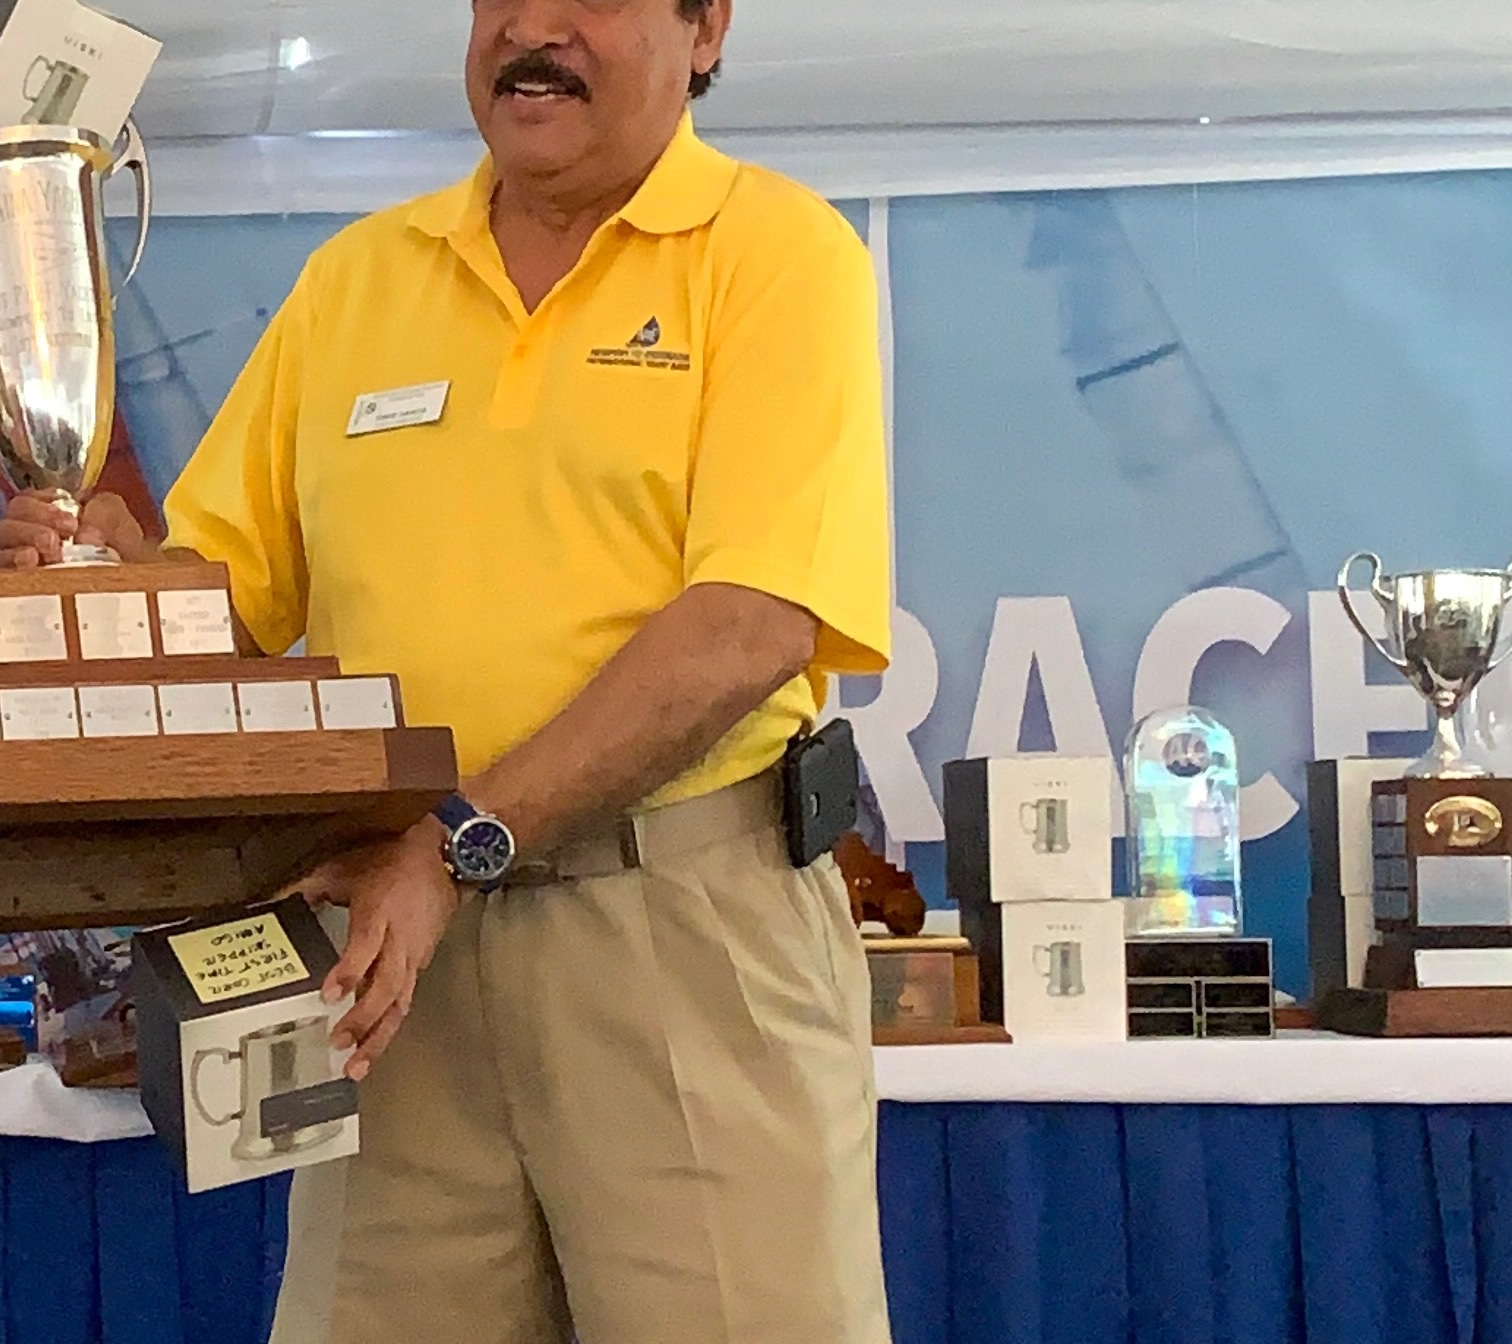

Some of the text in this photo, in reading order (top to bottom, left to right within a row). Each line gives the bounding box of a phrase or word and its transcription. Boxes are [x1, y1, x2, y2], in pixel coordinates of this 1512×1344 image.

[194, 947, 289, 982] FIRST TIME
[201, 938, 272, 967] SKIPPER
